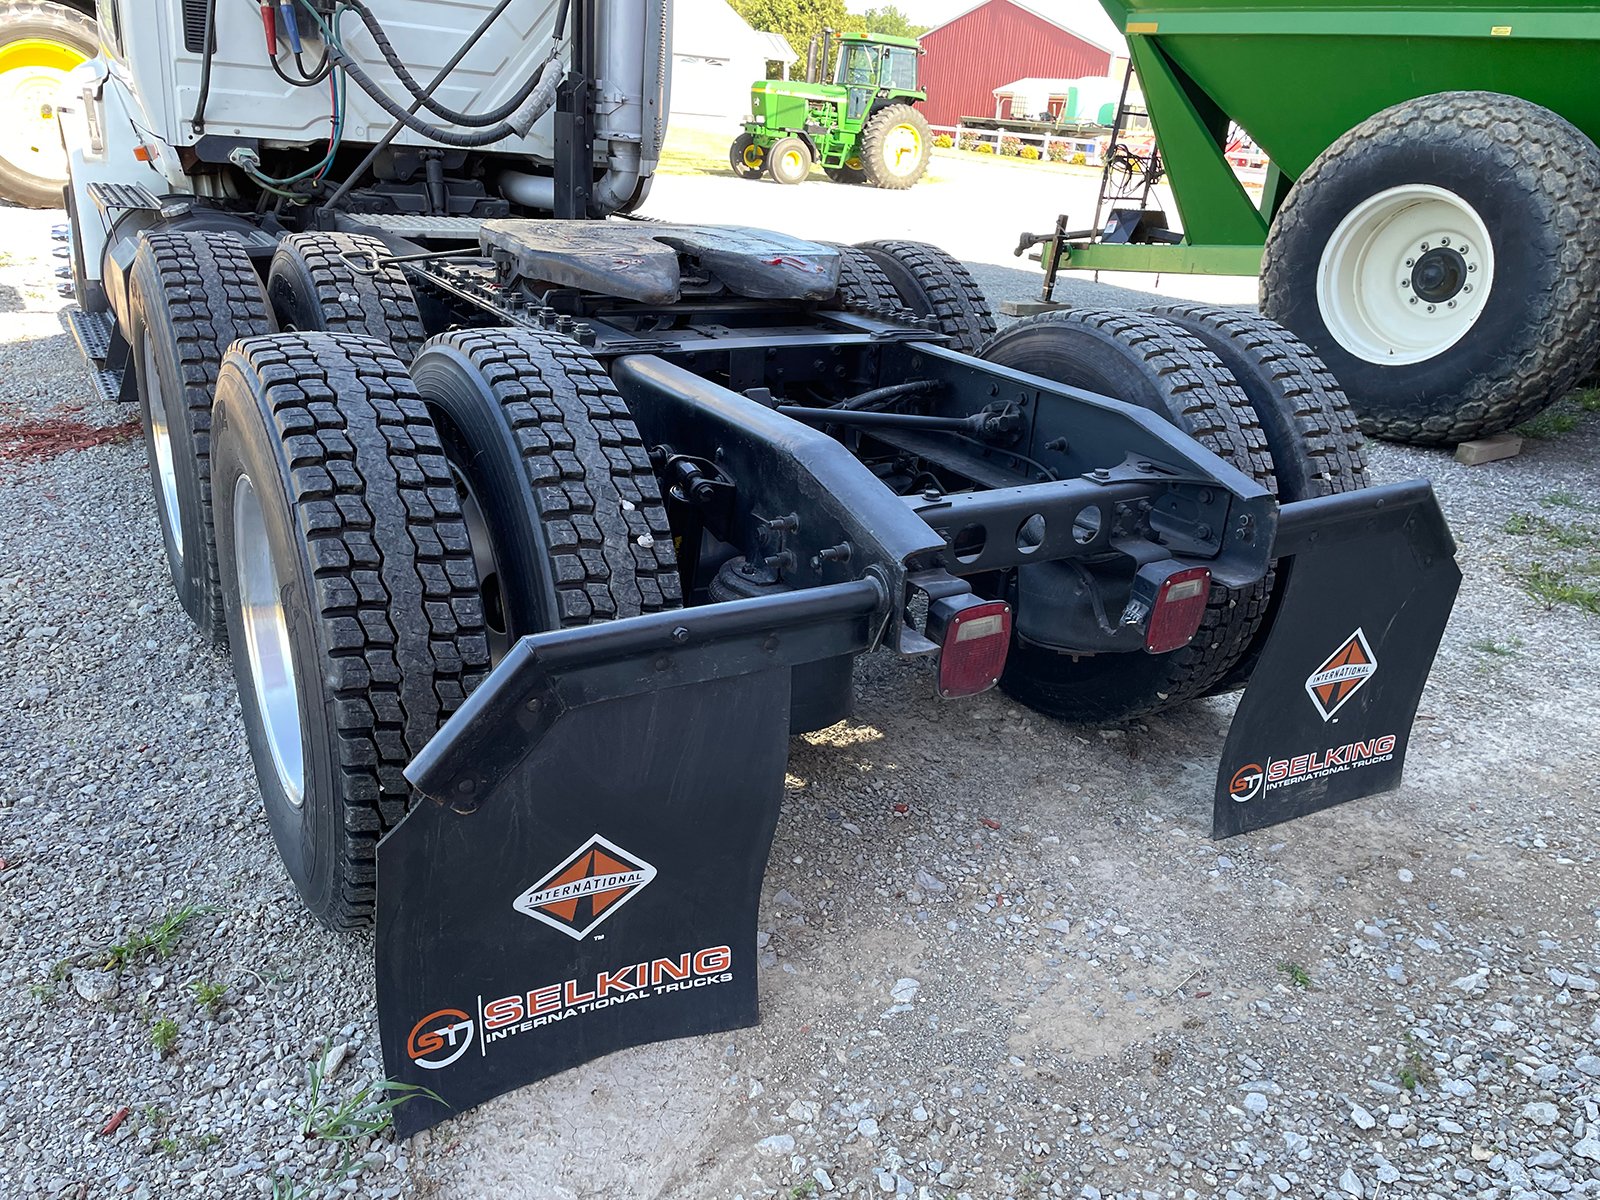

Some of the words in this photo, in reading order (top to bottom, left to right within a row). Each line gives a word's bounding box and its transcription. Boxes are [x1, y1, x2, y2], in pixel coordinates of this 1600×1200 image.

[1312, 665, 1370, 683] INTERNATIONAL
[1266, 764, 1350, 791] INTERNATIONAL
[1352, 753, 1393, 769] TRUCKS
[1267, 734, 1396, 782] SELKING
[528, 872, 643, 903] INTERNATIONAL
[484, 945, 732, 1029] SELKING
[486, 990, 650, 1043] INTERNATIONAL
[654, 972, 733, 995] TRUCKS
